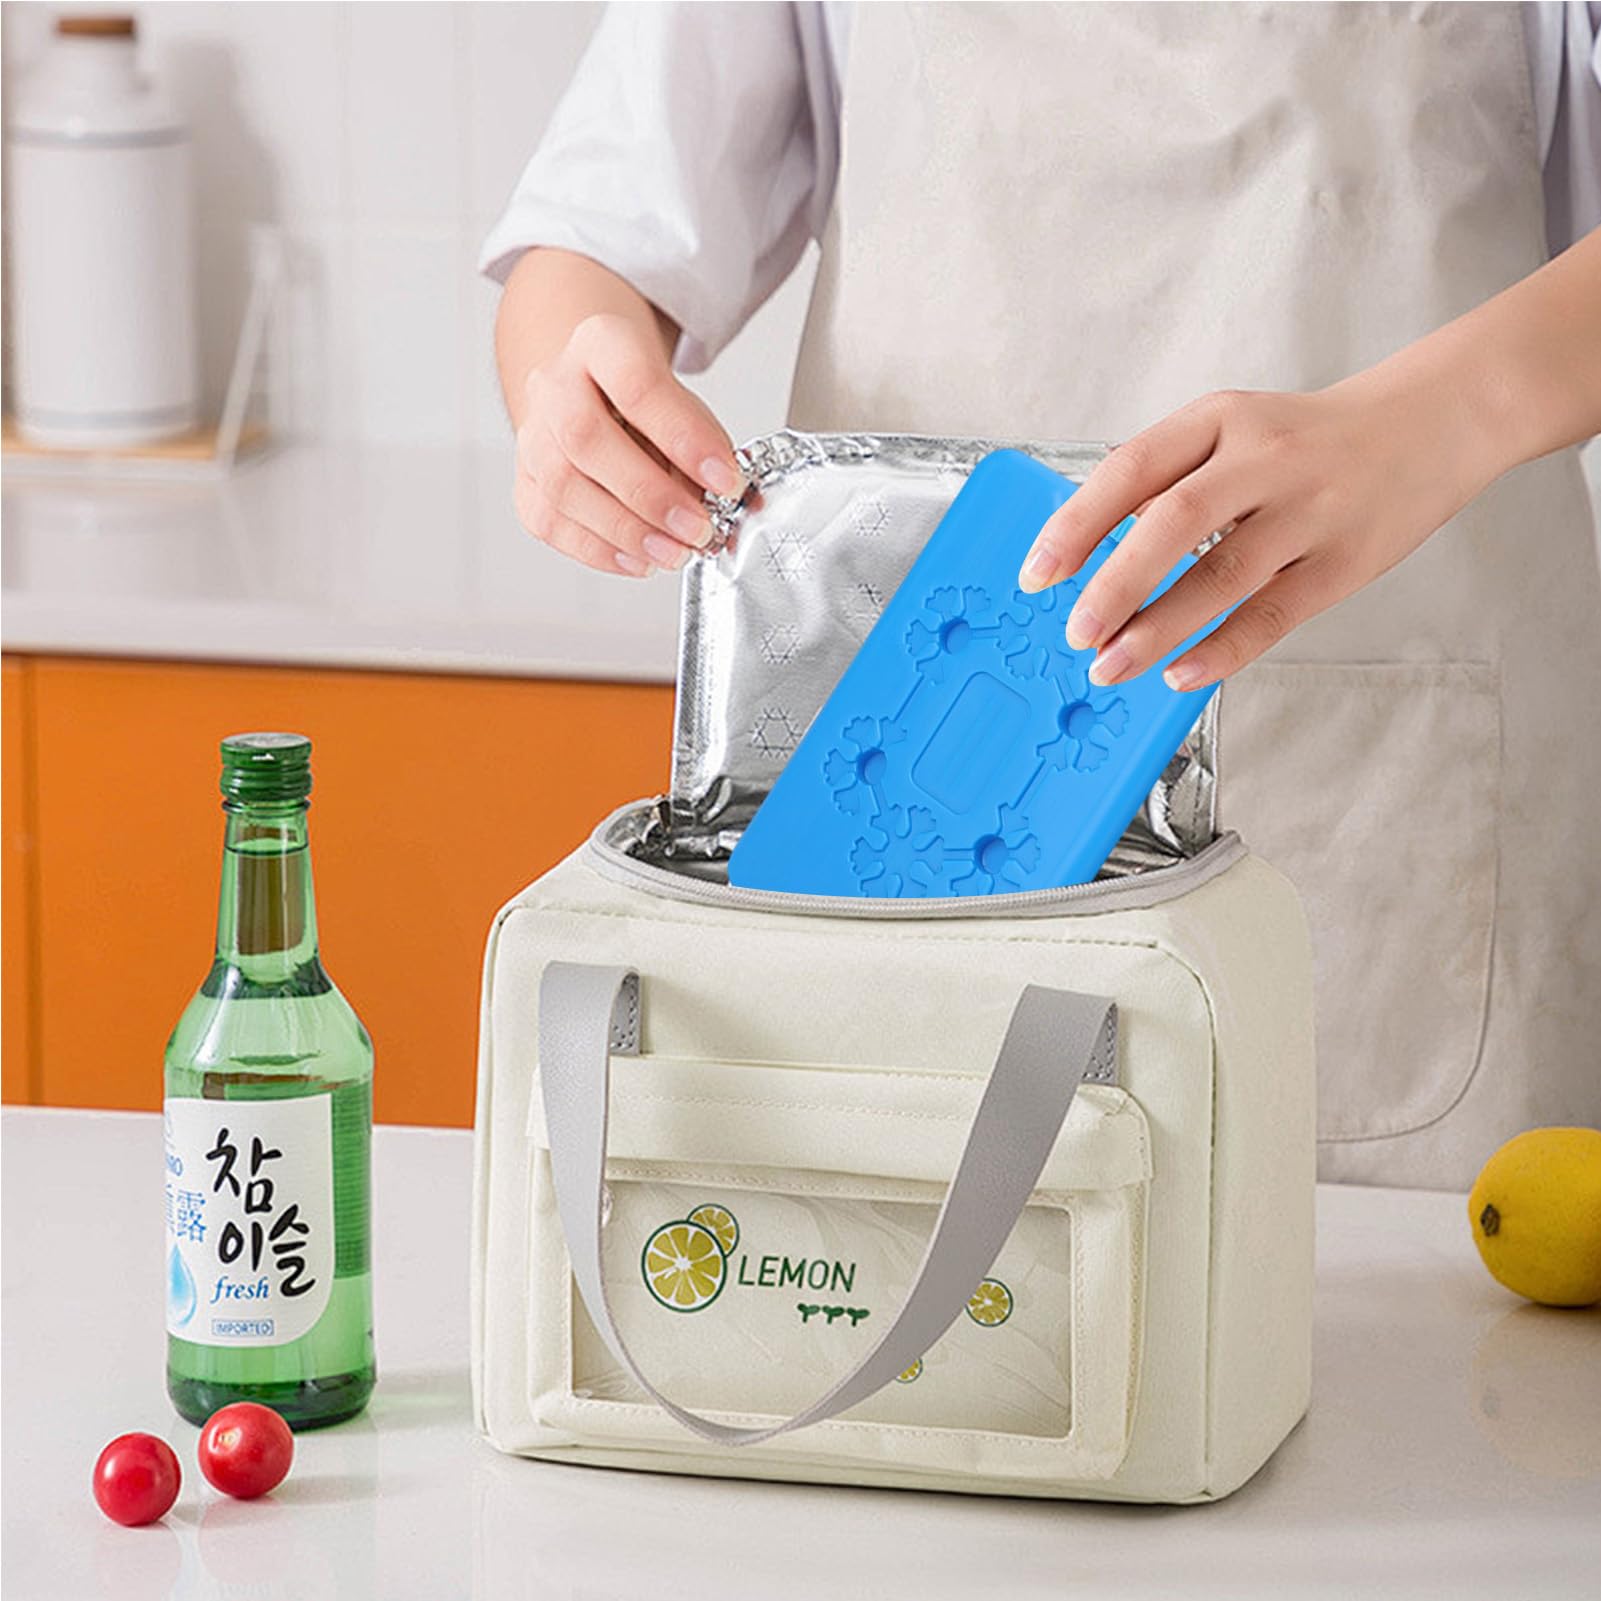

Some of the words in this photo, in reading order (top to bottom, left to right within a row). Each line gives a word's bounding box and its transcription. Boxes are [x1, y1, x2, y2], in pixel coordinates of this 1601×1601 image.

[738, 1255, 856, 1293] LEMON
[210, 1276, 270, 1304] fresh
[214, 1322, 272, 1335] IMPORTED
